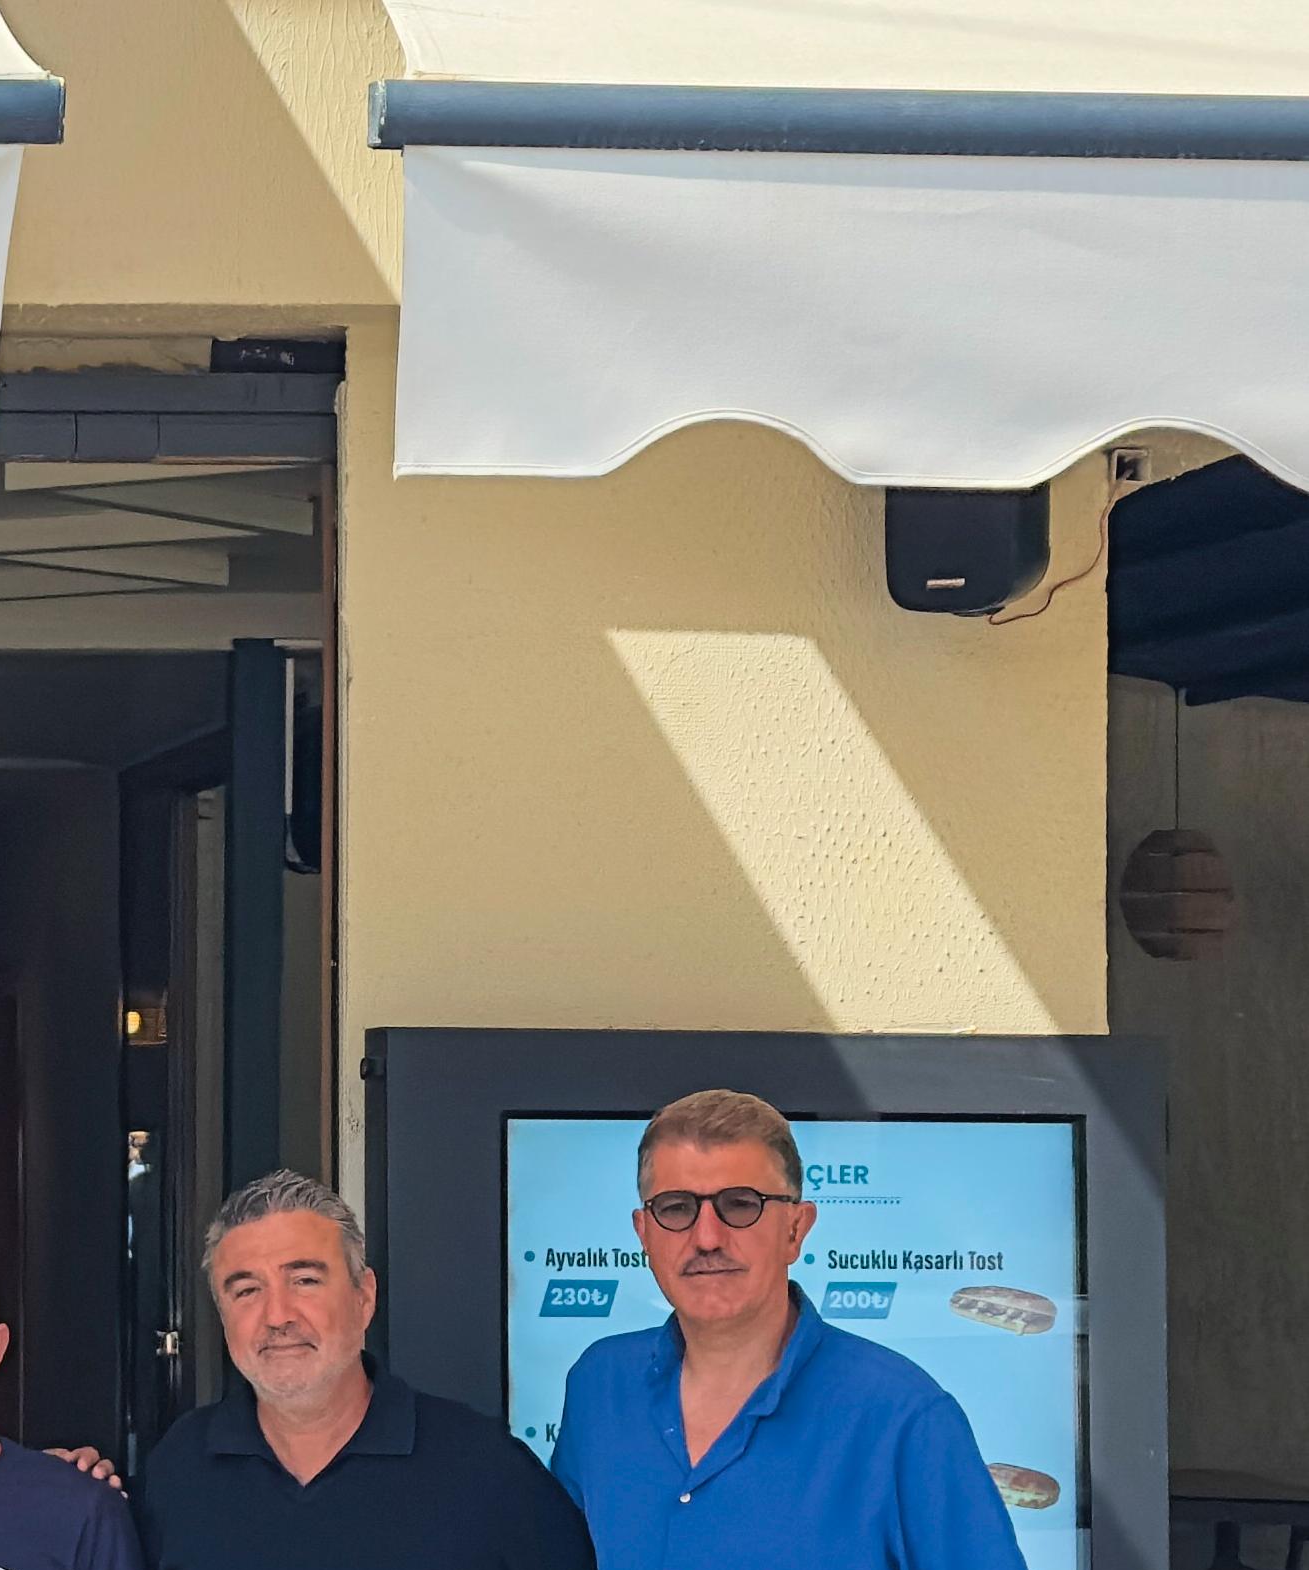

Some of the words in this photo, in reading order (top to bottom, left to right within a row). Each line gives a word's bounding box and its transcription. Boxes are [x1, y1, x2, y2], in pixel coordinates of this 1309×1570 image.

[545, 1247, 609, 1272] Ayvalık
[611, 1247, 647, 1268] Tost
[827, 1249, 898, 1270] Sucuklu
[968, 1250, 1004, 1271] Tost
[550, 1287, 609, 1306] 230₺
[829, 1290, 890, 1309] 200₺
